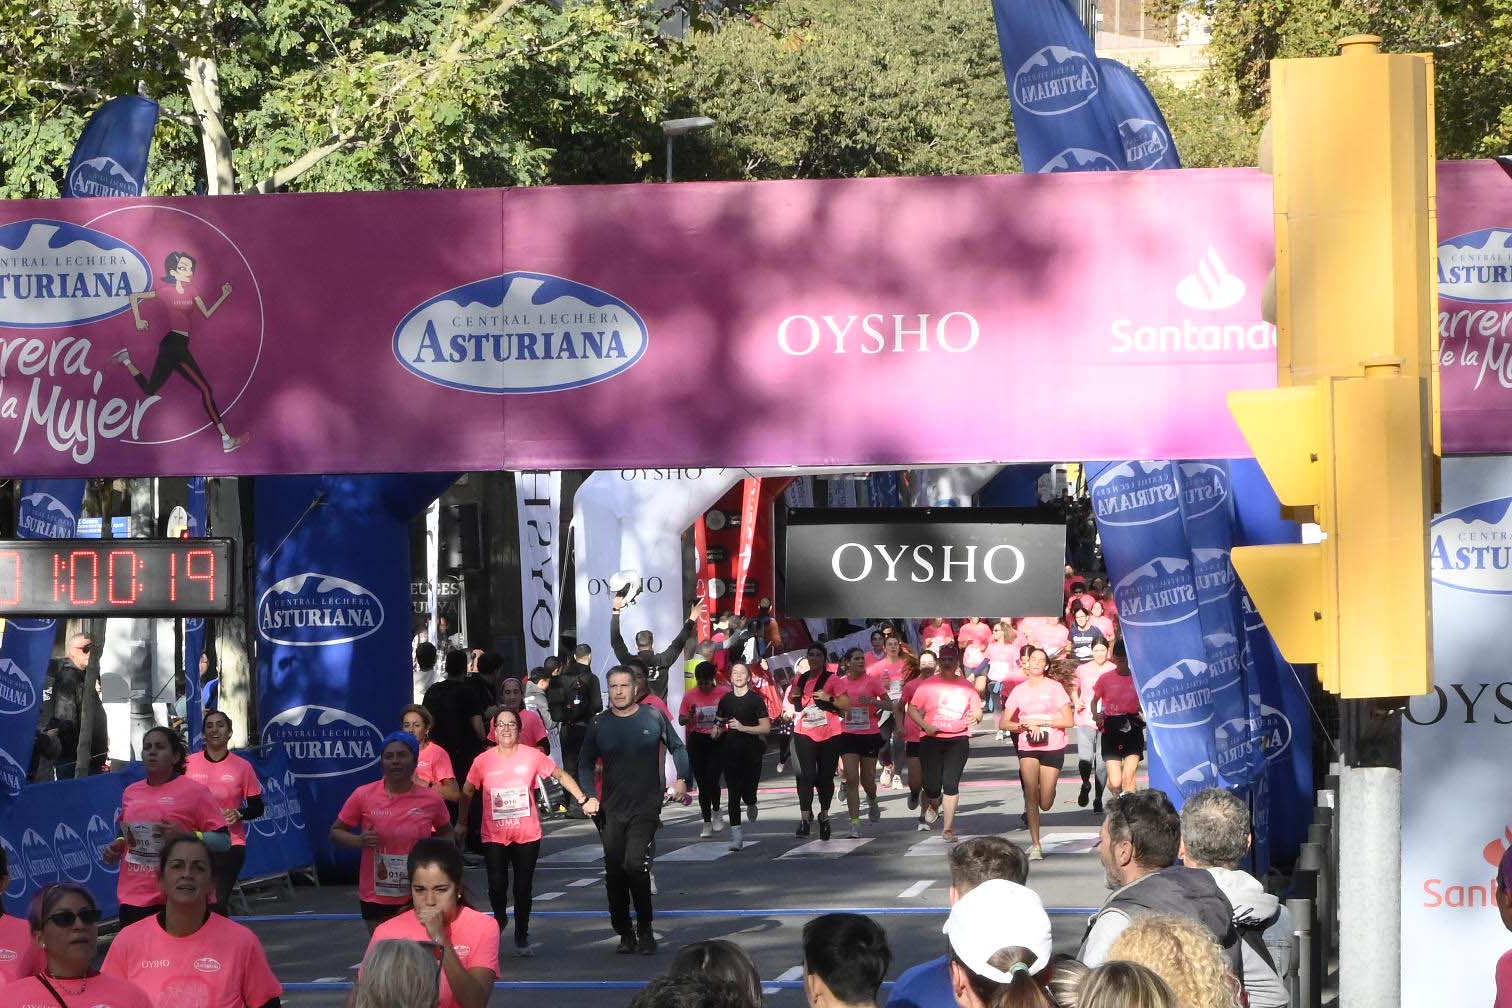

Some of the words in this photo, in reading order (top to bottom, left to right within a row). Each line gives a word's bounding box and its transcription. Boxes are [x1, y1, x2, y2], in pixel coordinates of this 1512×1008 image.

[55, 255, 127, 266] LECHERA
[452, 313, 530, 328] CENTRAL
[537, 311, 620, 325] LECHERA
[776, 311, 980, 356] OYSHO
[412, 320, 628, 363] ASTURIANA
[1111, 319, 1277, 353] Santand
[13, 372, 163, 464] Mujer
[831, 543, 1026, 584] OYSHO
[263, 601, 375, 628] ASTURIANA
[274, 598, 317, 607] CENTRAL
[320, 597, 371, 606] LECHERA
[276, 729, 319, 738] CENTRAL
[322, 728, 372, 737] LECHERA
